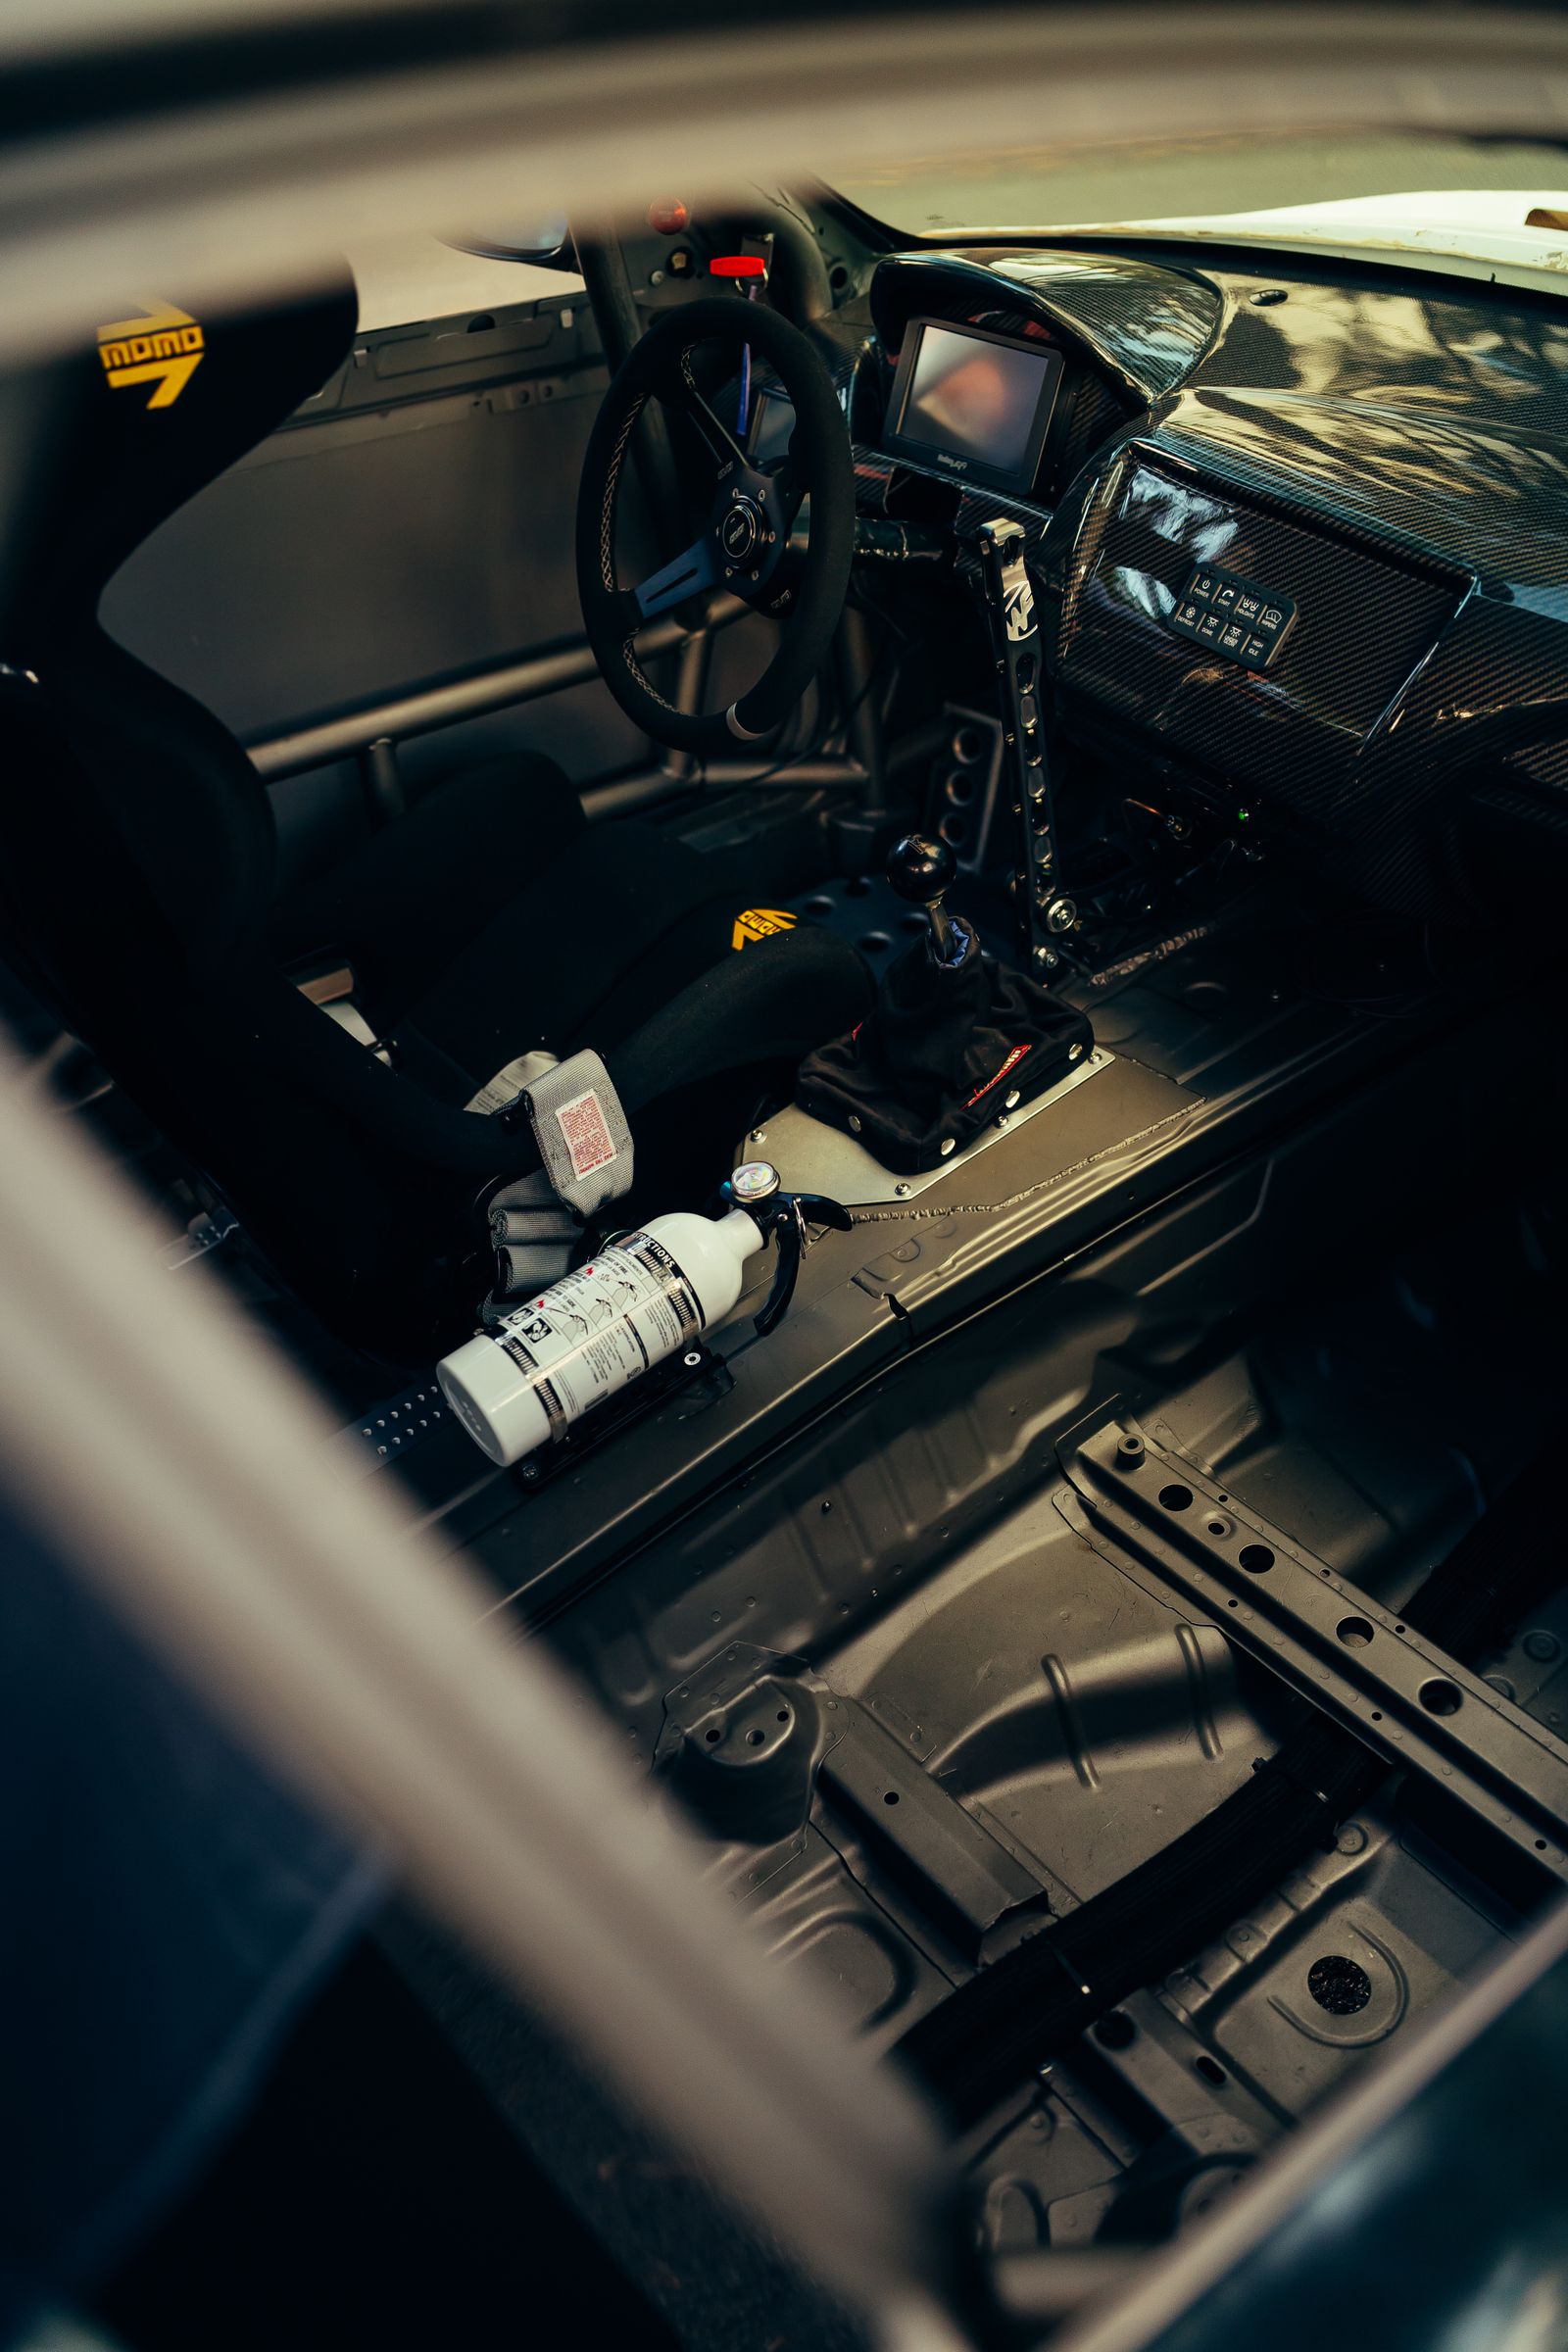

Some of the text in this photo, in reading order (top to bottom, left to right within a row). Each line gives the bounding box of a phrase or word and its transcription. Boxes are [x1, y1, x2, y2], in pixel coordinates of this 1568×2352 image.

[1194, 587, 1209, 598] POWER
[1217, 598, 1231, 607] START
[1177, 615, 1195, 627] DEFROST
[1260, 618, 1277, 630] WIPERS
[1200, 627, 1213, 637] DOME
[1251, 640, 1264, 649] HIGH
[1248, 648, 1259, 657] IDLE
